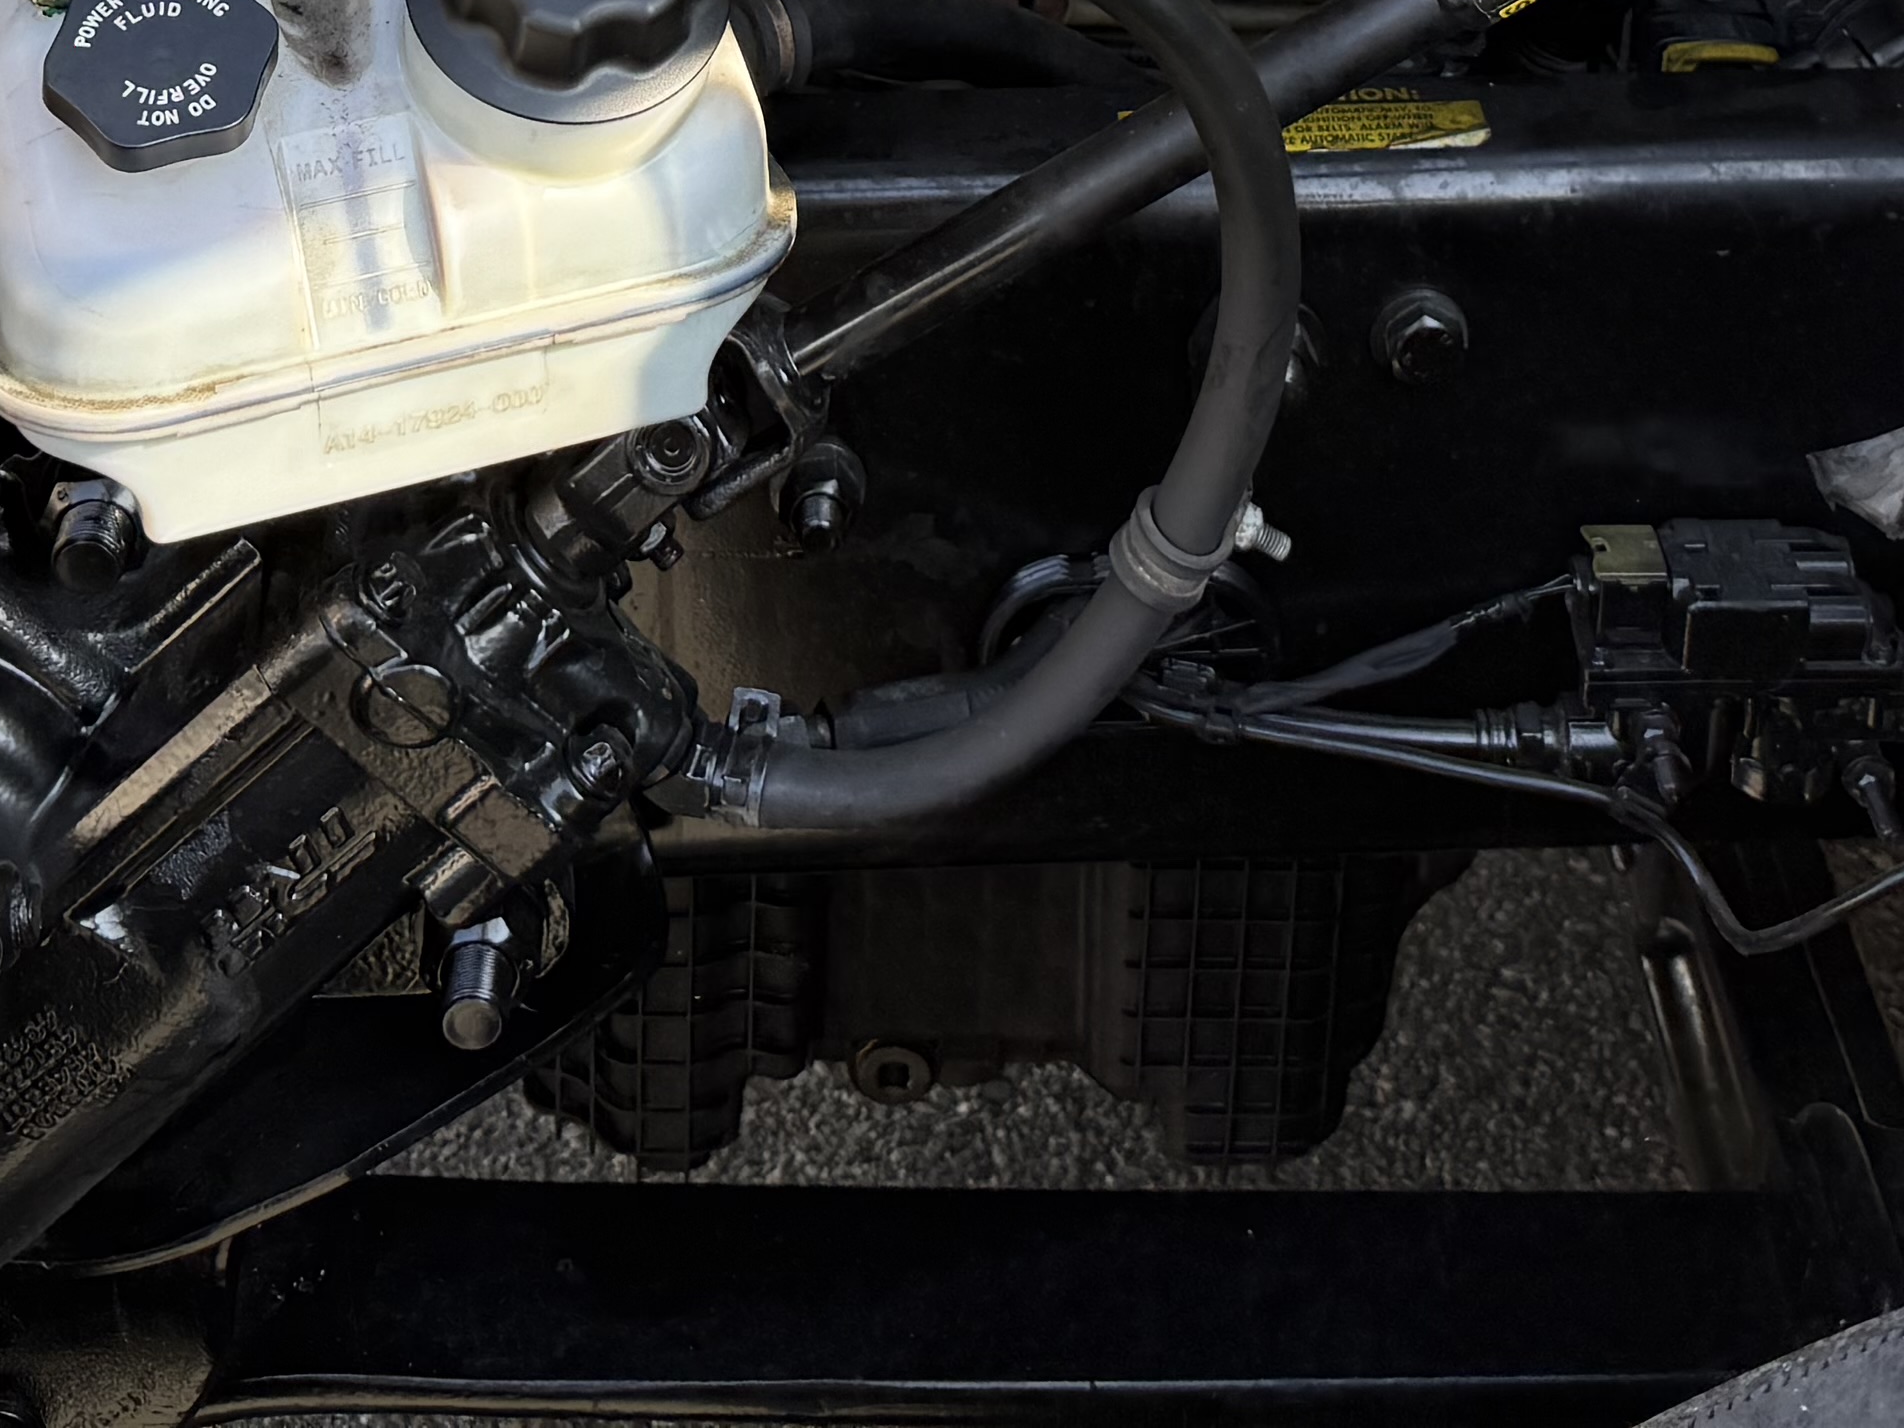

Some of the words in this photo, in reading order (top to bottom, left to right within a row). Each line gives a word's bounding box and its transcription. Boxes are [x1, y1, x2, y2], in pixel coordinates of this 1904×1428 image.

[113, 1, 182, 32] FLUID
[121, 62, 218, 106] OVERFILL
[136, 108, 180, 126] NOT
[187, 94, 217, 117] DO
[1295, 125, 1313, 134] OR
[1359, 122, 1404, 132] ALARM
[1300, 133, 1374, 145] AUTOMATIC
[298, 157, 342, 182] MAX
[353, 144, 405, 173] FILL
